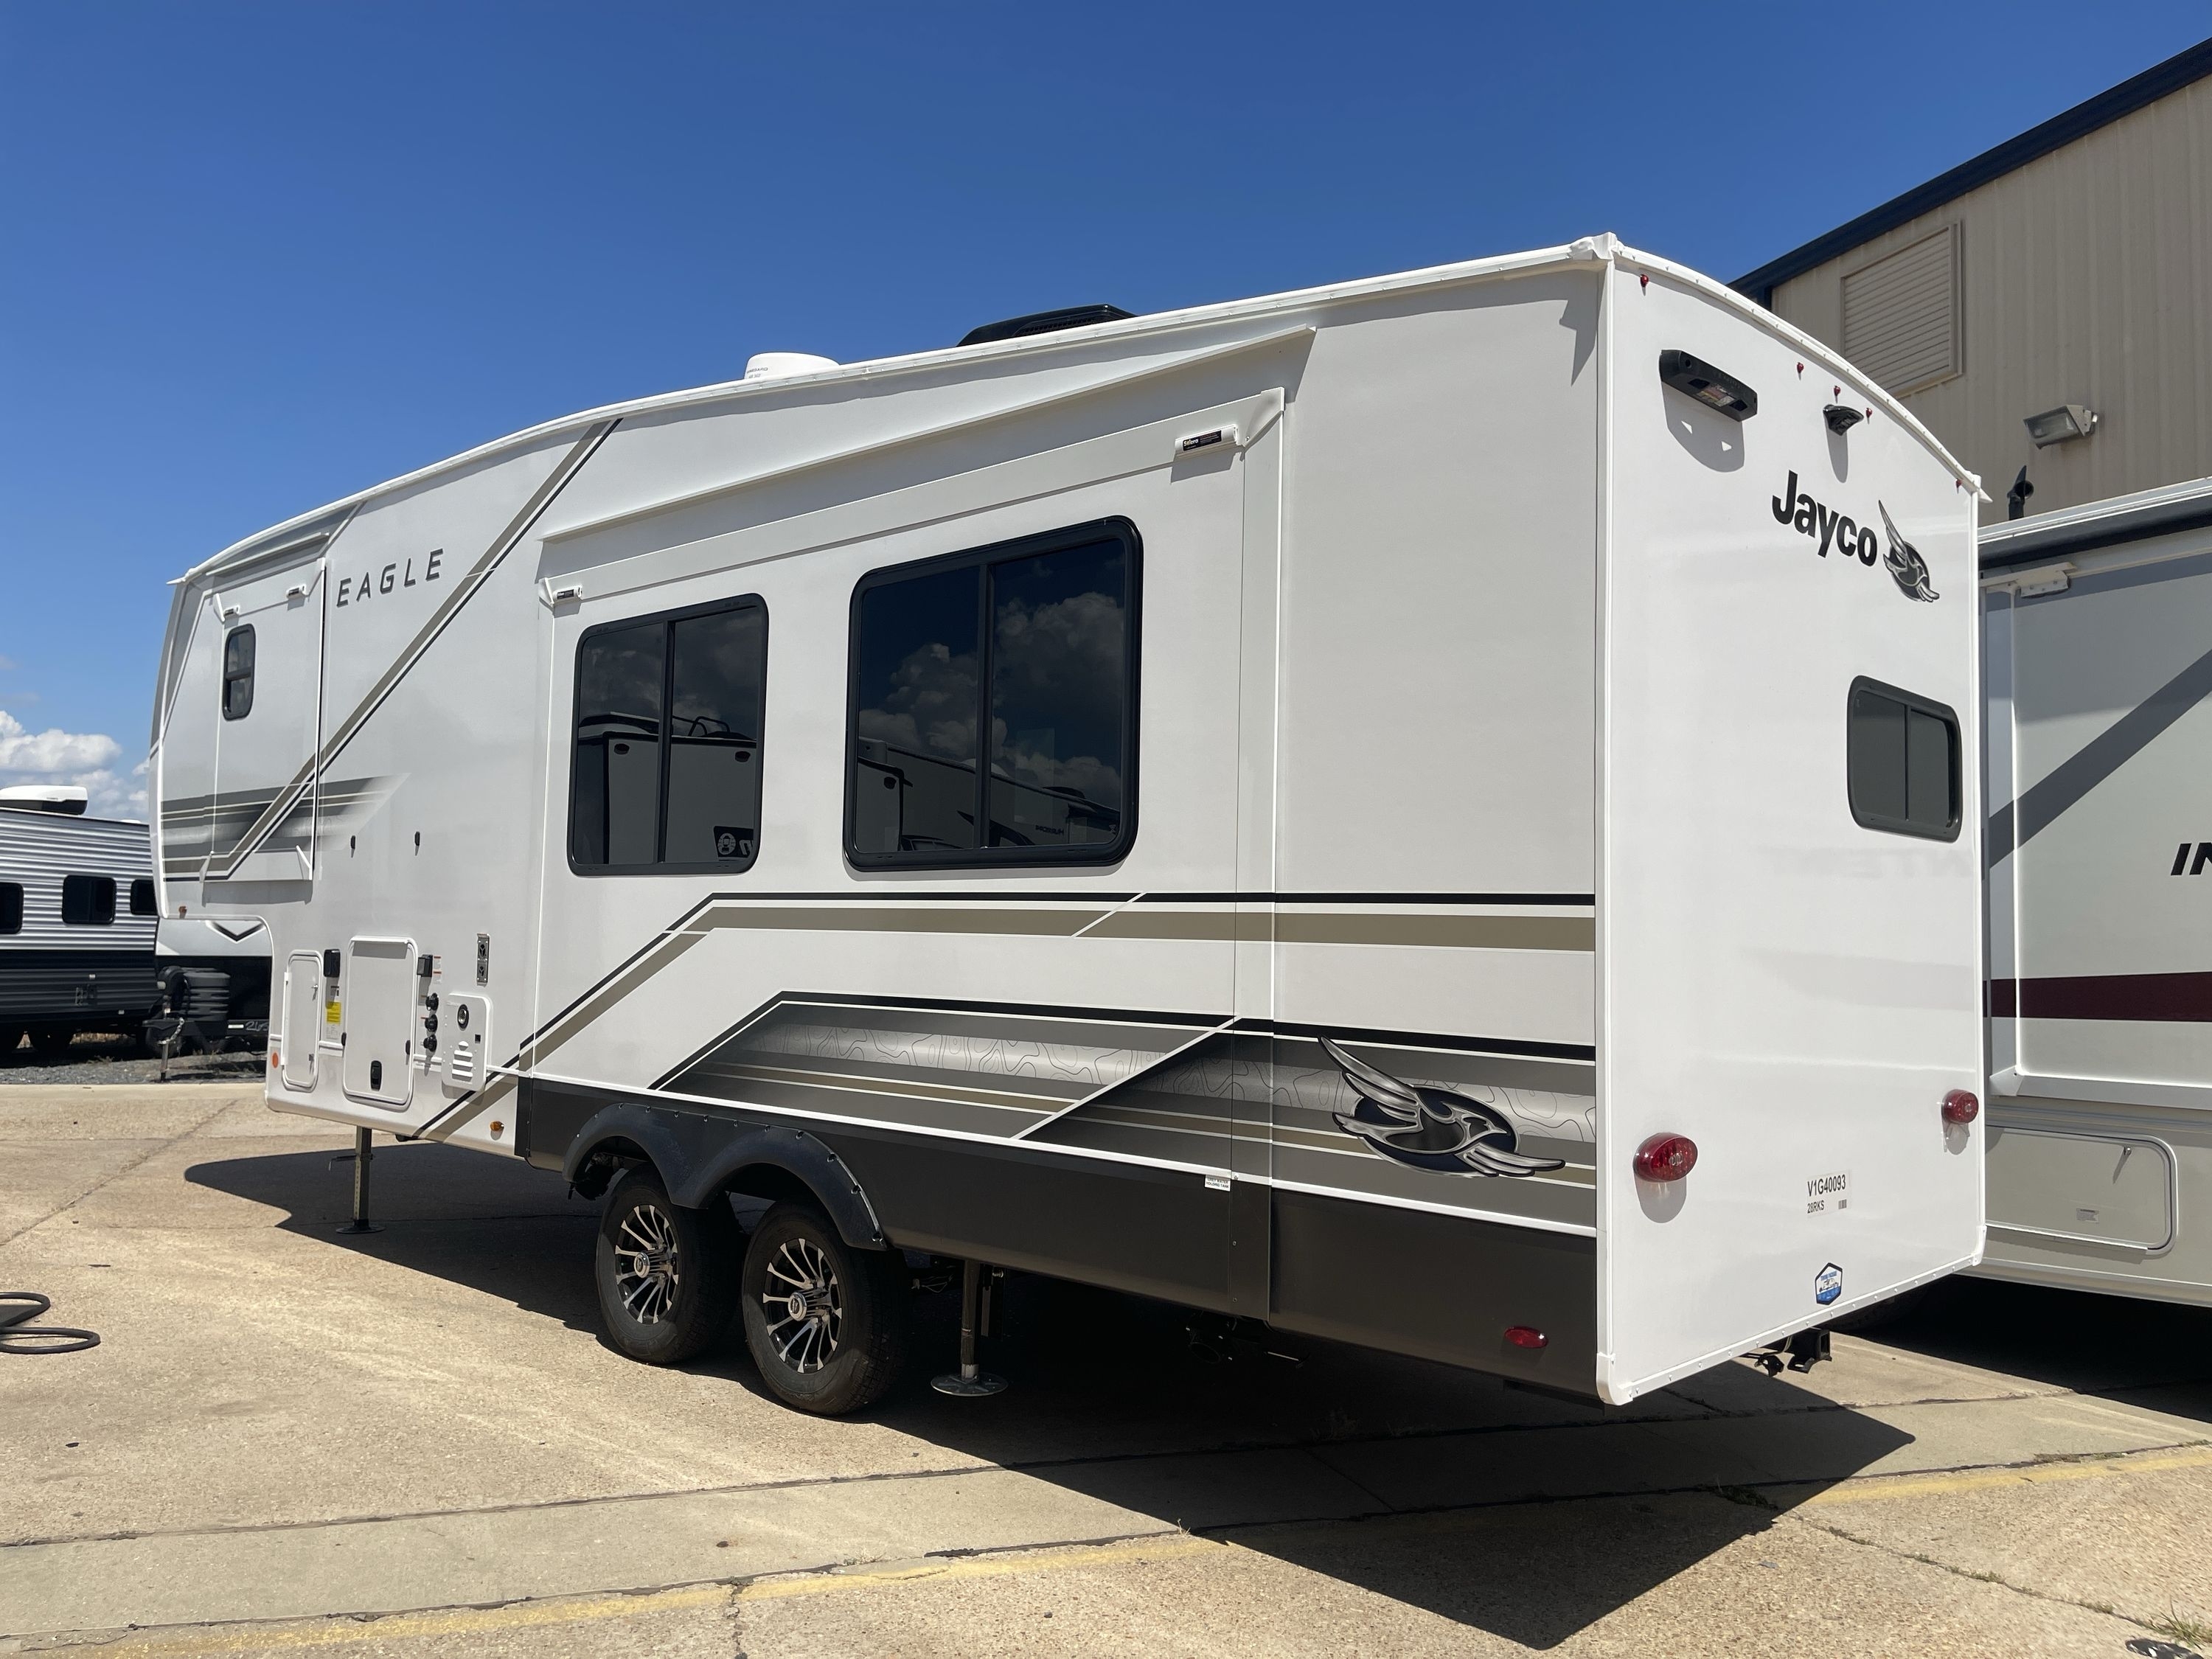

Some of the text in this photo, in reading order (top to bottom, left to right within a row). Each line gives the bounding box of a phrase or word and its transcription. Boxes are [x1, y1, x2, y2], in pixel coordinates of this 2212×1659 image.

[1772, 470, 1877, 567] Jayco
[336, 548, 444, 608] EAGLE
[1807, 1174, 1846, 1197] V1G40093
[1807, 1200, 1825, 1214] 28RKS
